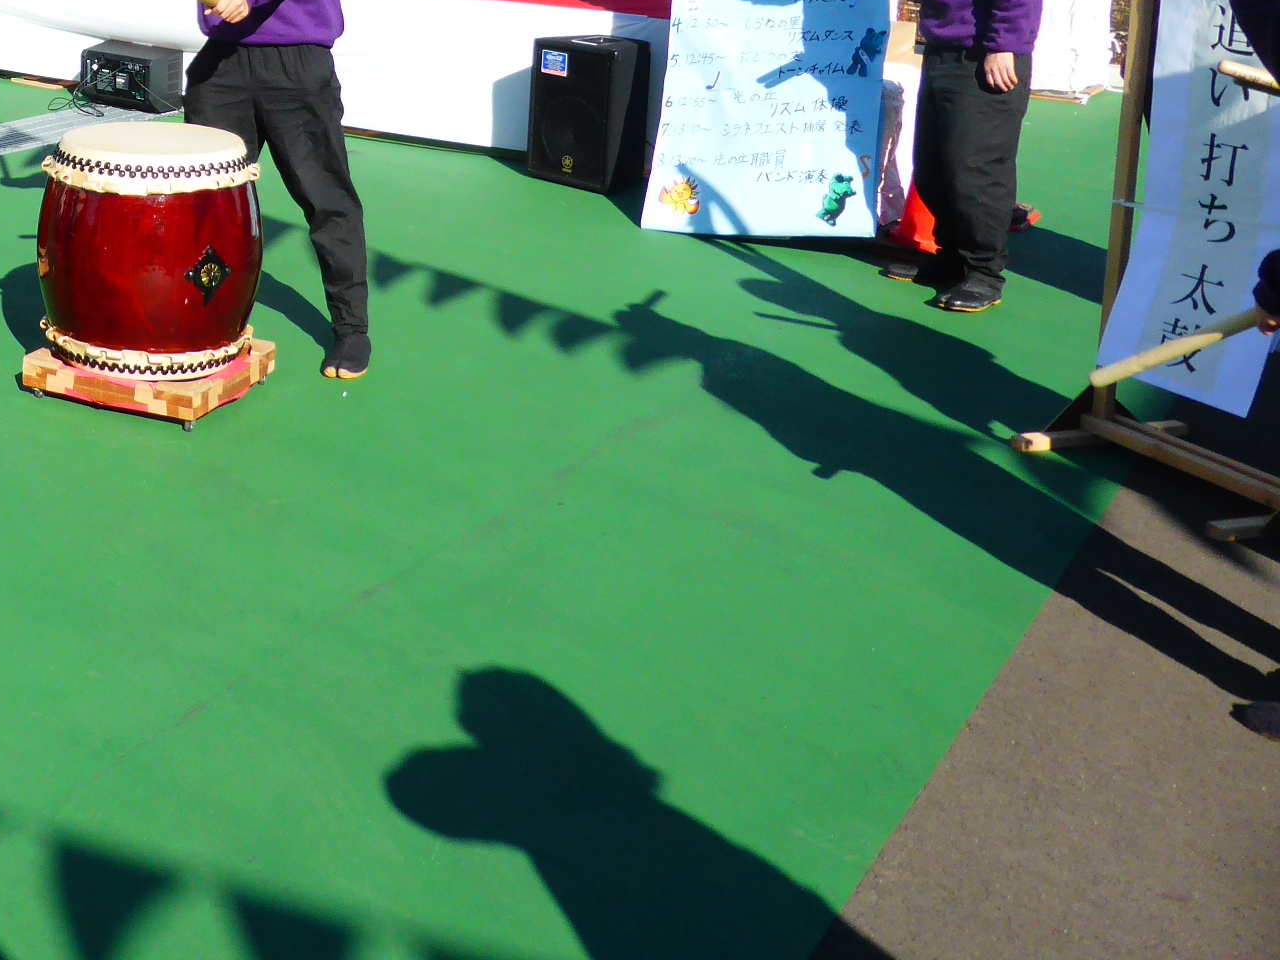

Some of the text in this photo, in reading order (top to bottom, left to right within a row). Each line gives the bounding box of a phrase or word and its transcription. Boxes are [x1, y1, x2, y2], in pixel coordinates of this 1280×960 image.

[788, 29, 854, 45] リズムダンス
[778, 62, 845, 80] トーンチャイム
[732, 90, 777, 104] 光の丘
[756, 169, 830, 185] バンド演奏
